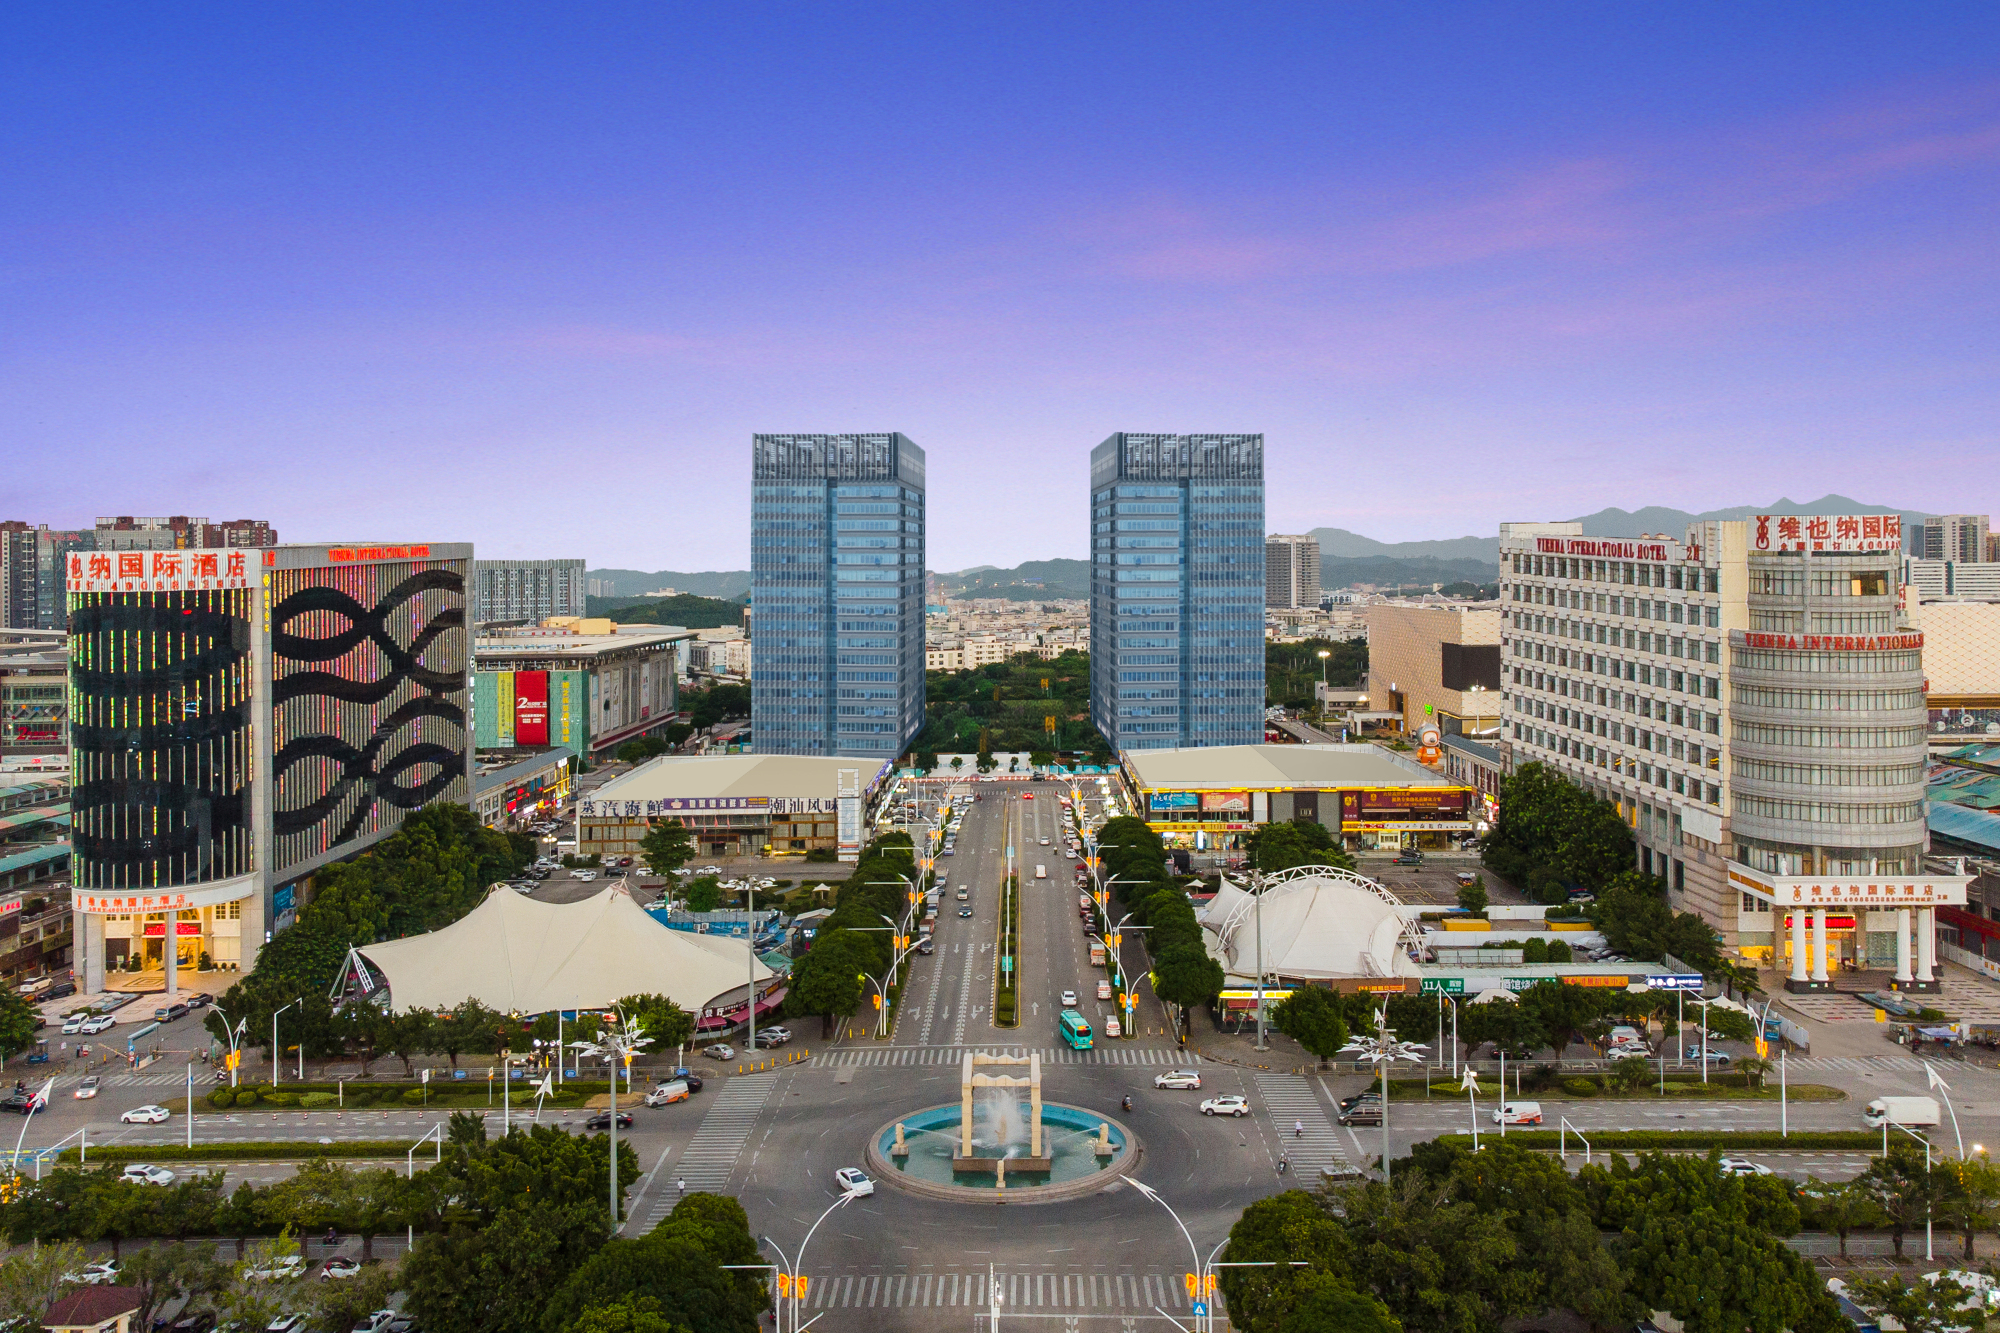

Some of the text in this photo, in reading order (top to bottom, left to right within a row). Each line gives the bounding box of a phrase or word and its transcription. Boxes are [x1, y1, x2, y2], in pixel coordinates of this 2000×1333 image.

[1537, 538, 1564, 554] VIENNA
[66, 551, 247, 580] 也纳国际酒店
[1745, 633, 1797, 649] VIENNA
[580, 800, 664, 818] 蒸汽海鲜
[770, 797, 838, 814] 潮汕风味
[1811, 884, 1934, 896] 维也纳国际酒店
